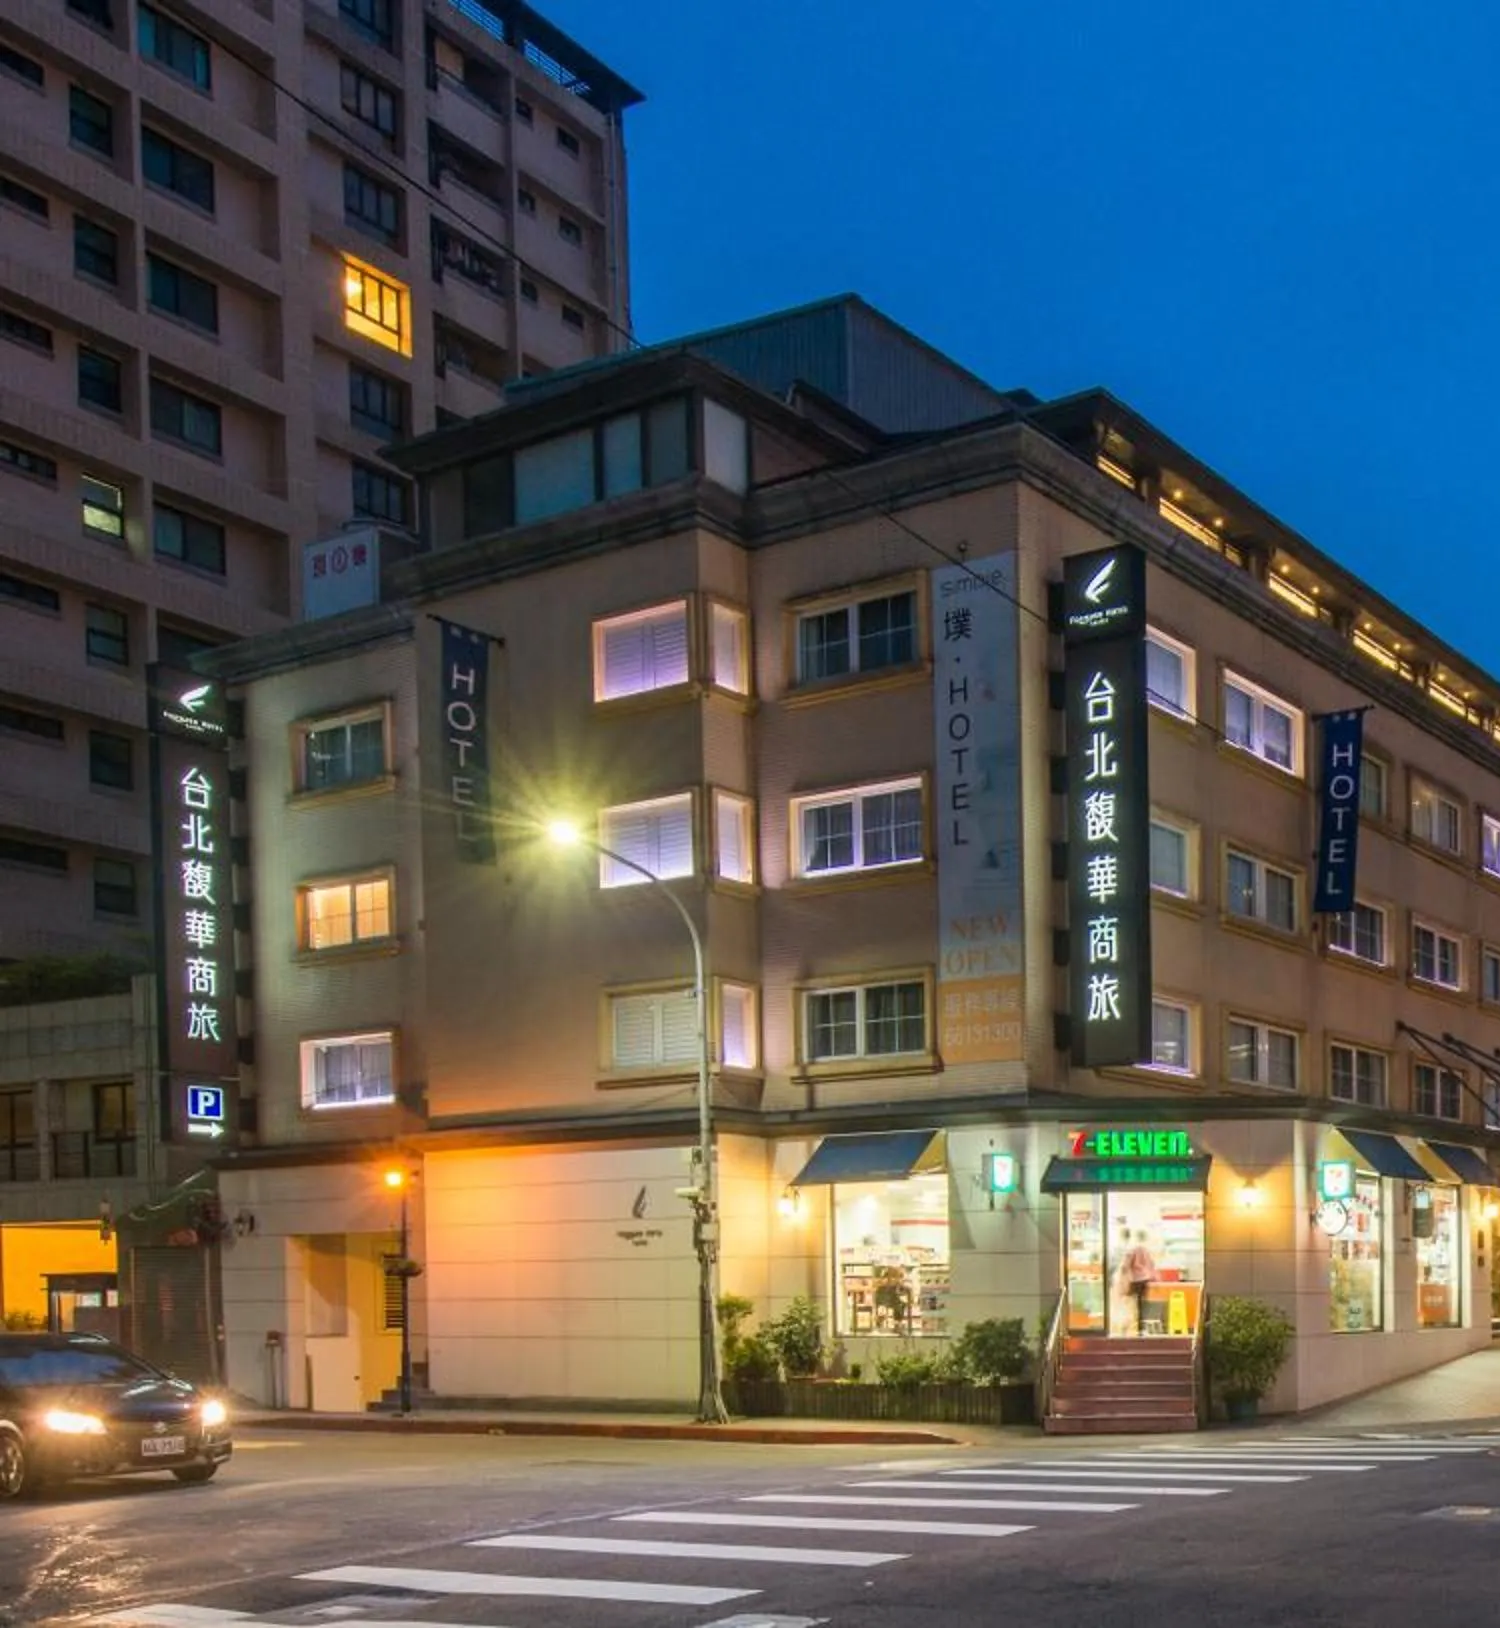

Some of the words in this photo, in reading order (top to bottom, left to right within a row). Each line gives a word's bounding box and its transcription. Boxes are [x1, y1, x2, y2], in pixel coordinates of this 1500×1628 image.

[447, 664, 478, 842] HOTEL
[1326, 744, 1354, 895] HOTEL
[181, 767, 221, 1042] 台北馥華商旅
[1085, 671, 1121, 1022] 台北馥華商旅
[944, 945, 1018, 975] OPEN
[952, 911, 1008, 941] NEW
[198, 1090, 213, 1117] P
